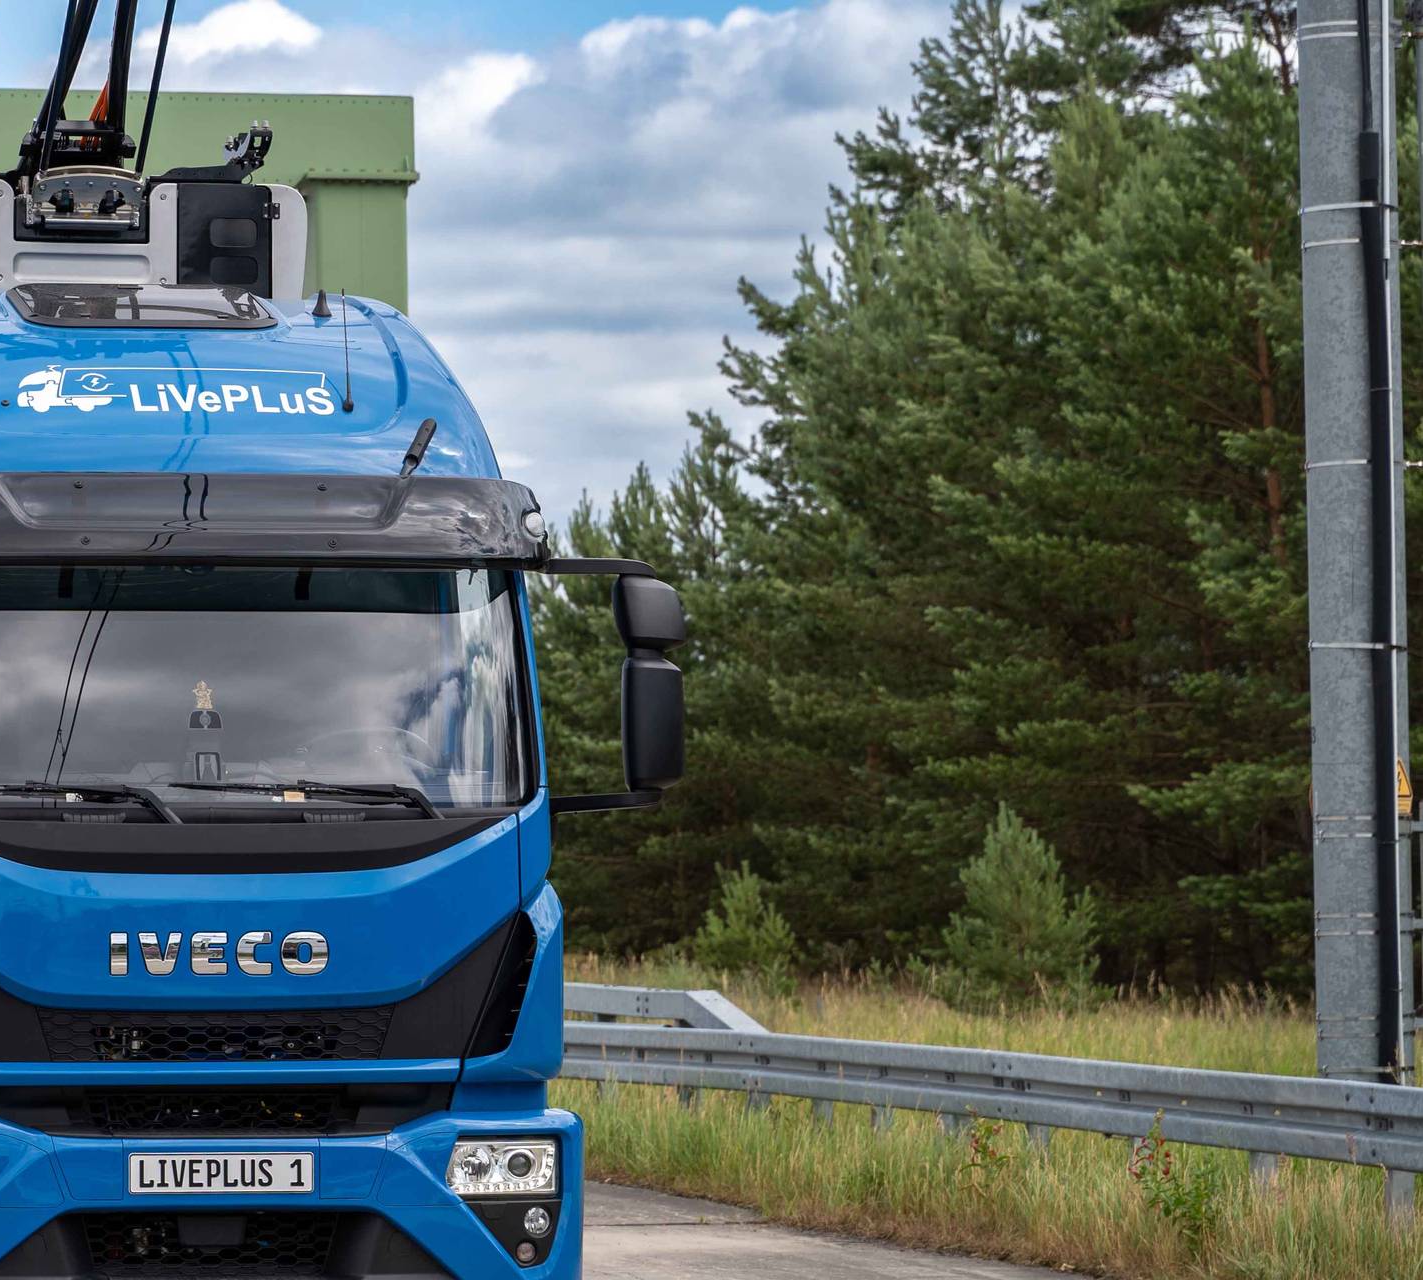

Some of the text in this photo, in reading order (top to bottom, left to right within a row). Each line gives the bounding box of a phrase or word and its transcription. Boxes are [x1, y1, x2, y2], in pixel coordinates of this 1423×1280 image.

[129, 382, 335, 416] LiVePLuS
[109, 931, 329, 976] IVECO
[139, 1158, 305, 1188] LIVEPLUS 1
